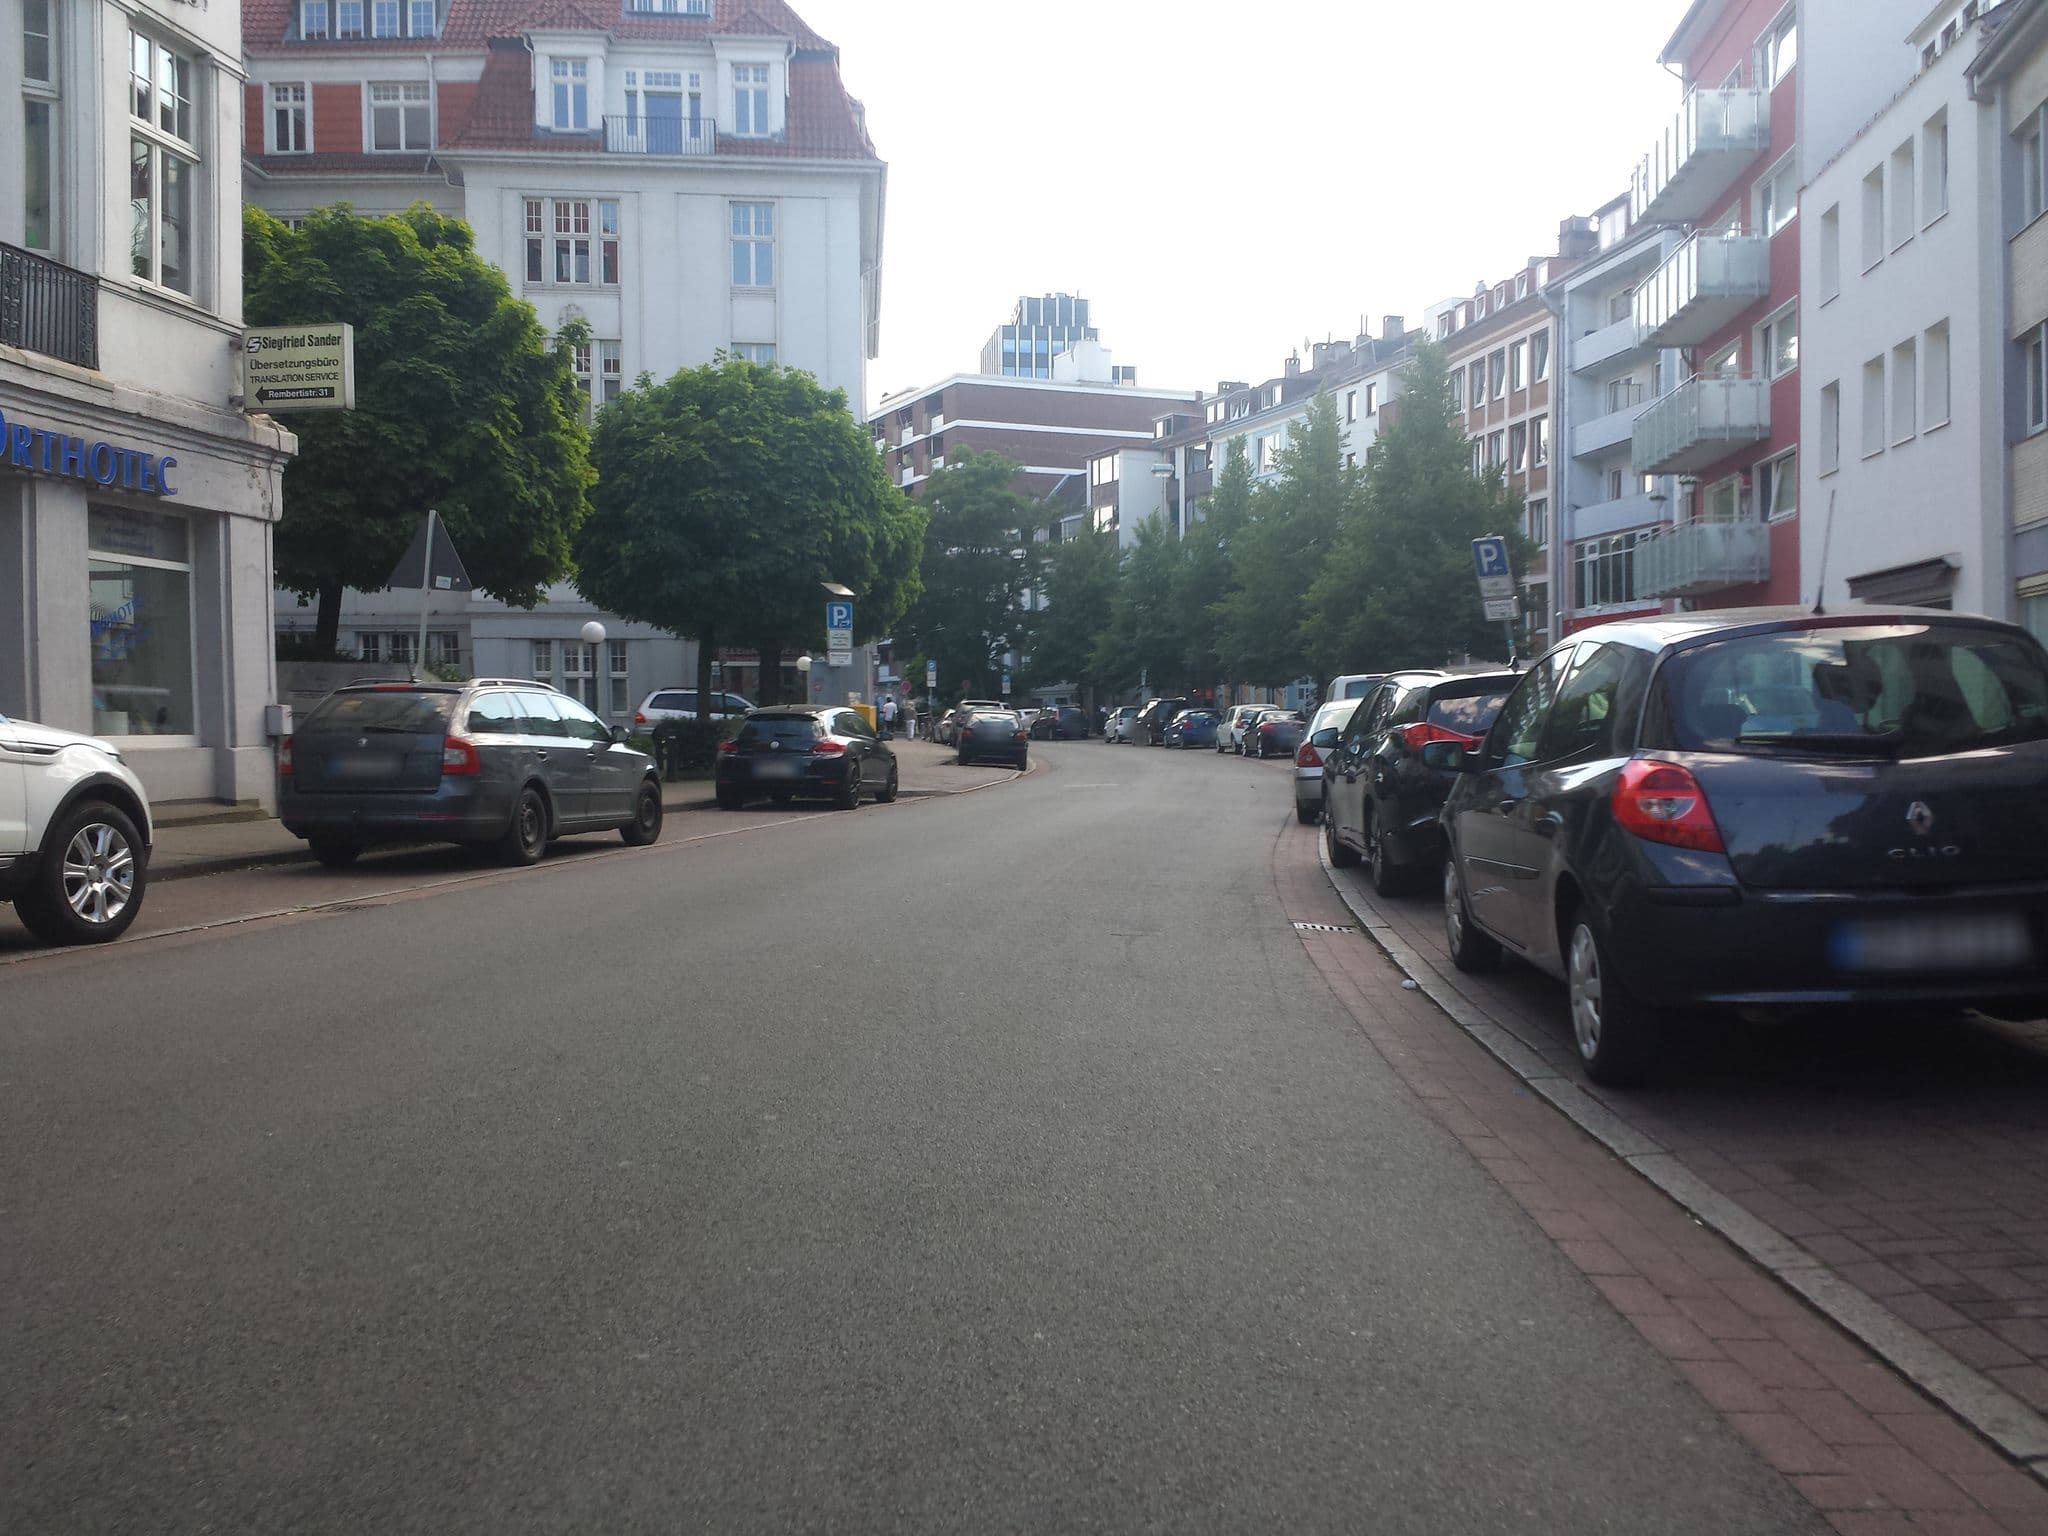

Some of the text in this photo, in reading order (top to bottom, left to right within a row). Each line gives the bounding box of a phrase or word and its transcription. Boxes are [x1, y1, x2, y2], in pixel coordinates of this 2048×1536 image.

[262, 335, 305, 350] Siegfried
[307, 334, 342, 347] Sander
[250, 358, 339, 370] Übersetzungsbüro
[250, 372, 340, 384] TRANSLATION SERVICE
[268, 388, 329, 398] Rembertistr. 31
[0, 408, 178, 496] RTHOTEC
[1479, 543, 1498, 574] P
[833, 606, 847, 626] P
